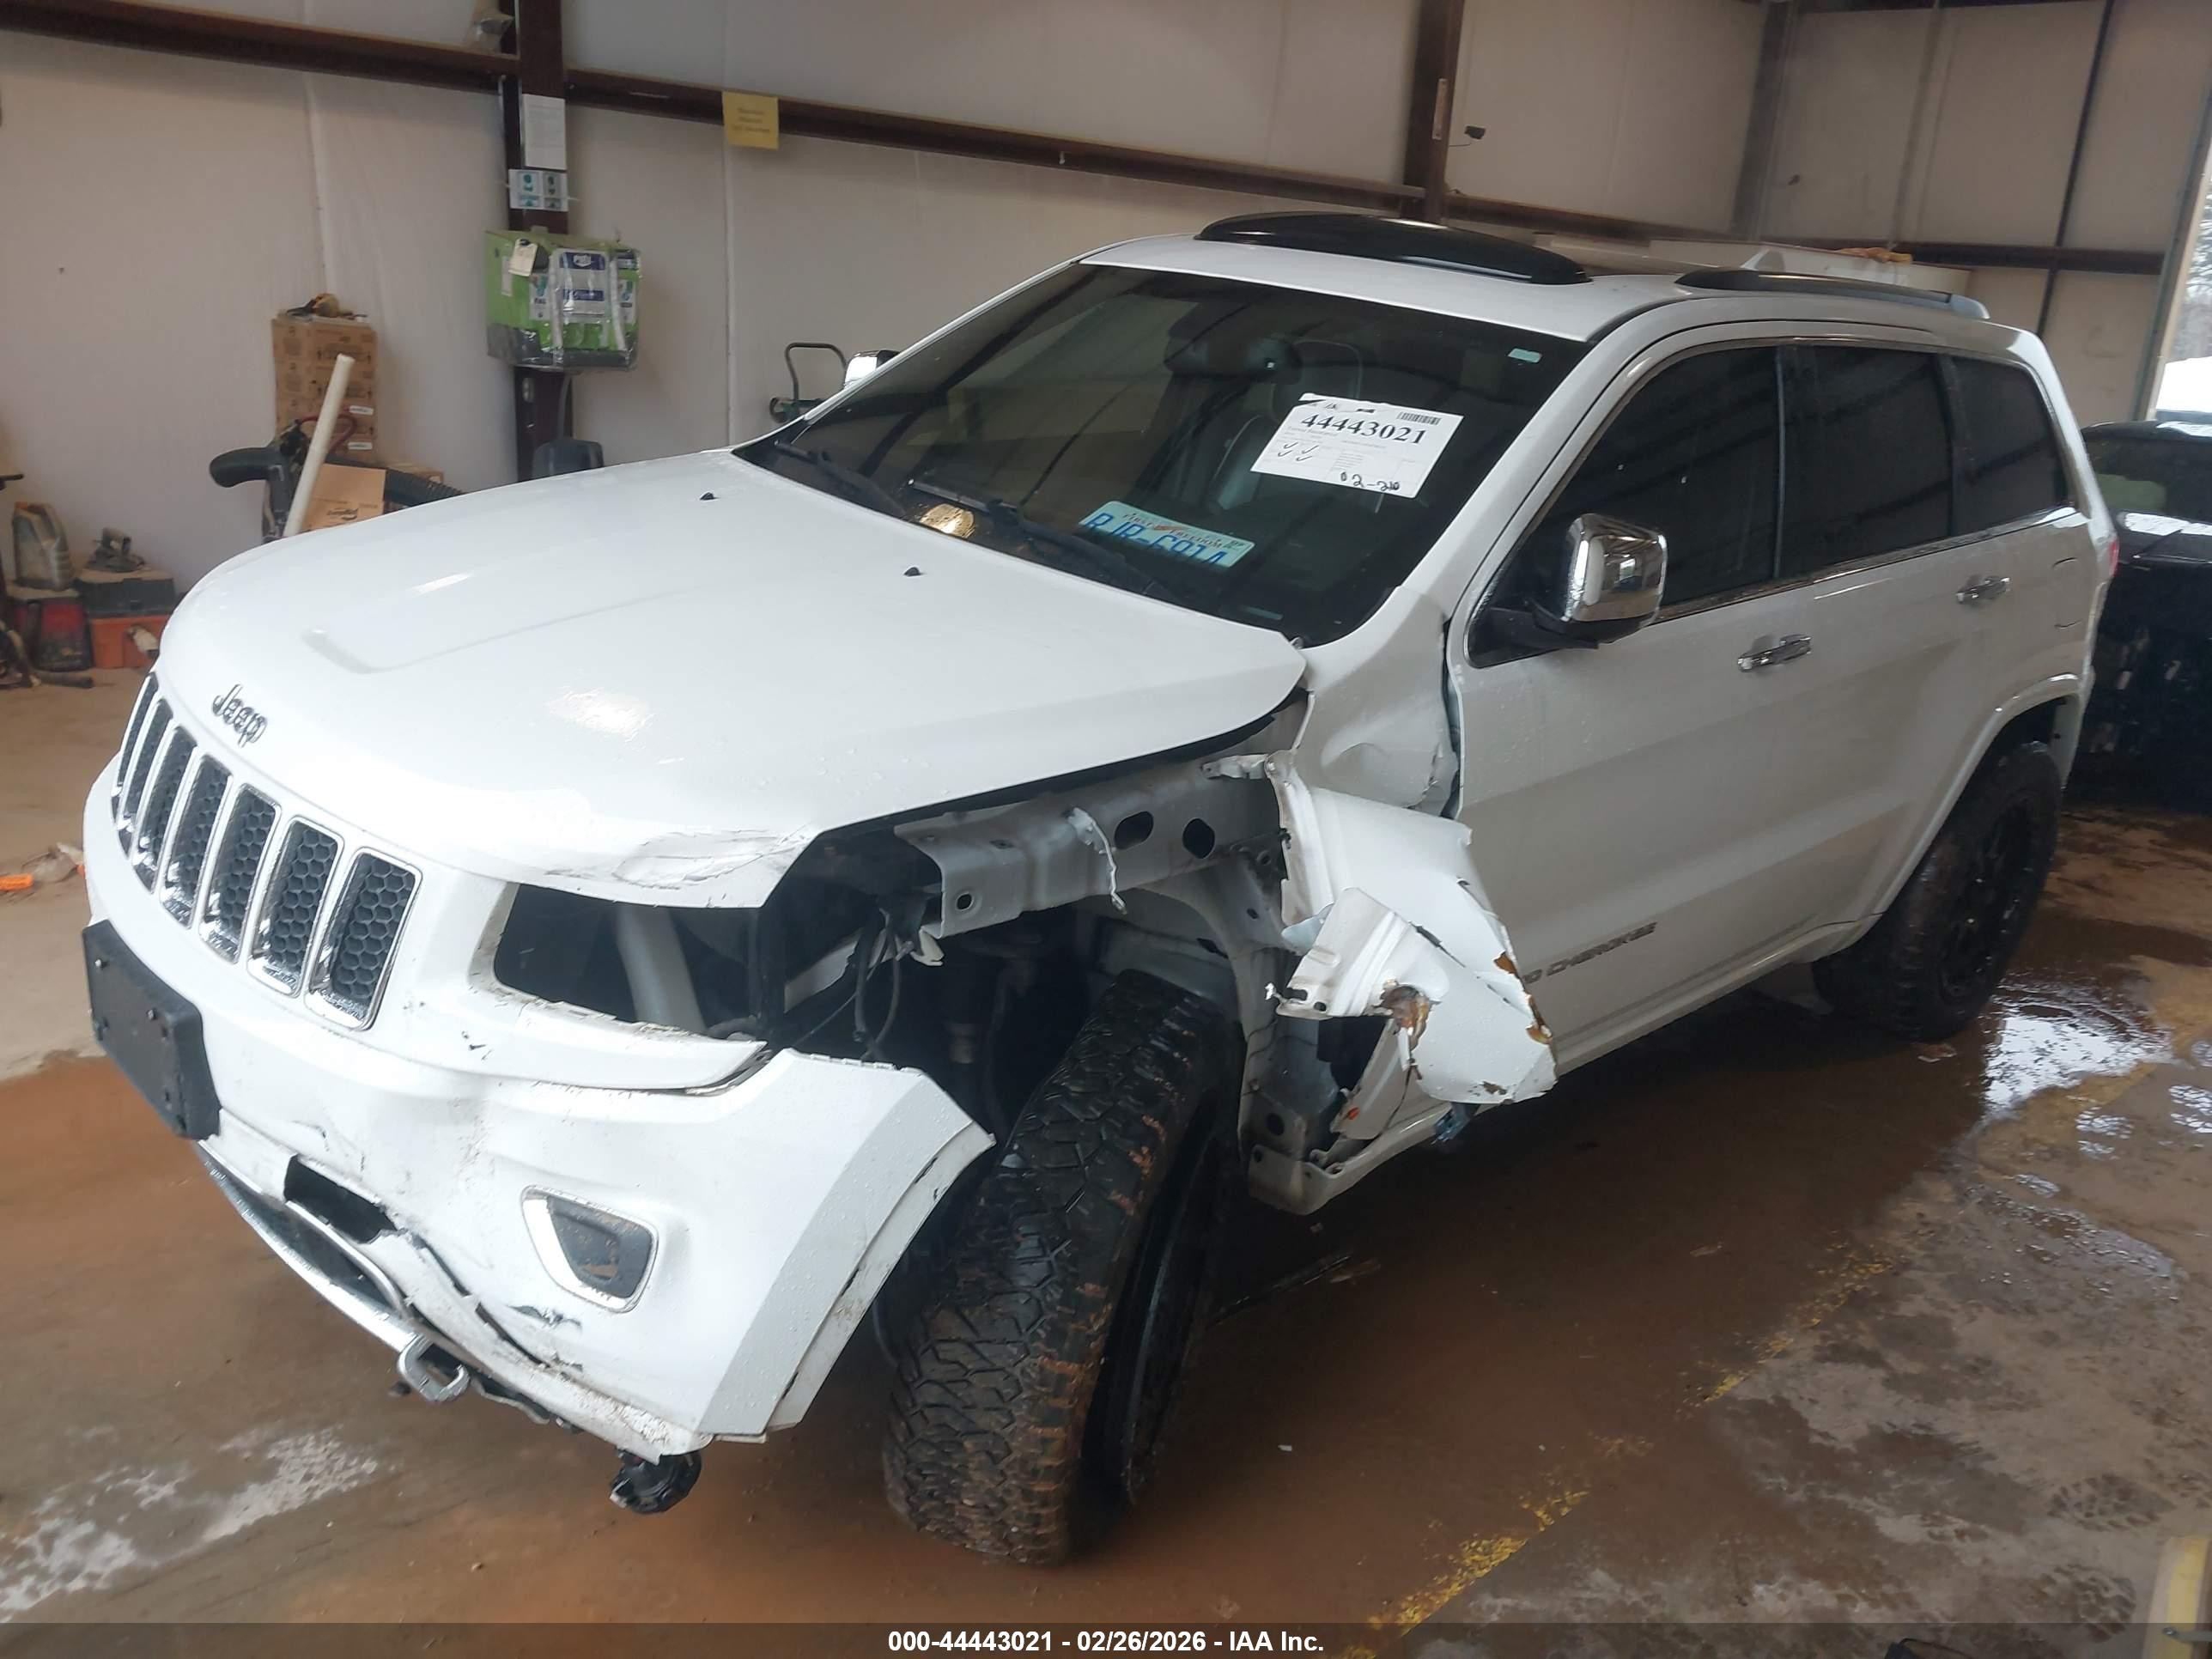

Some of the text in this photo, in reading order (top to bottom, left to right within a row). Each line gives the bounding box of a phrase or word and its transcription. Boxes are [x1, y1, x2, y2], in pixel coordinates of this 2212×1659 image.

[1301, 413, 1427, 444] 44443021
[212, 684, 269, 749] Jeep
[1546, 921, 1658, 977] CHEROKEE
